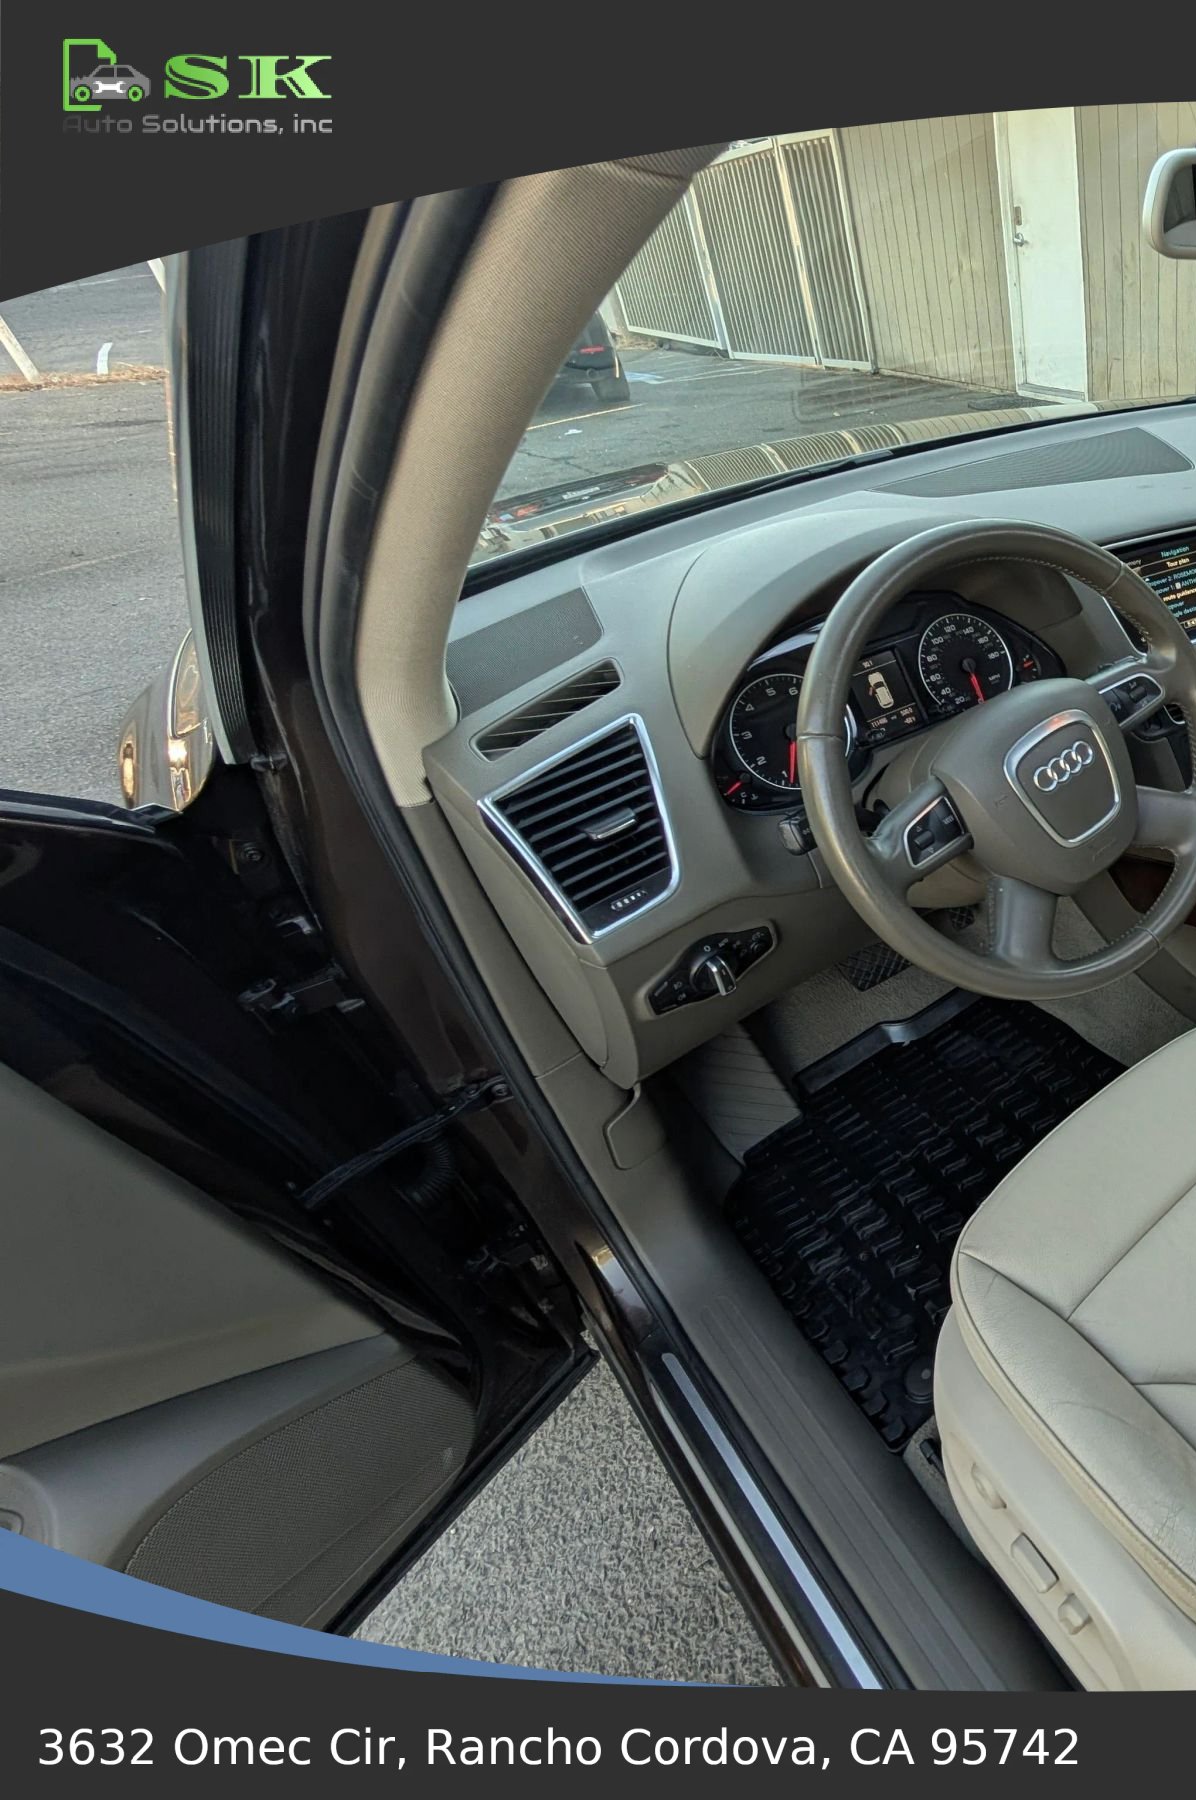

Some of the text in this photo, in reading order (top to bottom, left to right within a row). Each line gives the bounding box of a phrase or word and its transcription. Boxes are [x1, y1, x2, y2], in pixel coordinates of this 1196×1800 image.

[1160, 546, 1190, 558] Navigation
[1166, 557, 1190, 568] Tour plan
[962, 626, 974, 635] 140
[931, 636, 944, 645] 100
[926, 654, 938, 662] 80
[929, 673, 941, 682] 60
[765, 687, 777, 697] 5
[788, 686, 799, 696] 6
[941, 687, 951, 695] 40
[954, 696, 965, 704] 20
[745, 703, 755, 712] 4
[741, 731, 753, 740] 3
[756, 756, 767, 766] 2
